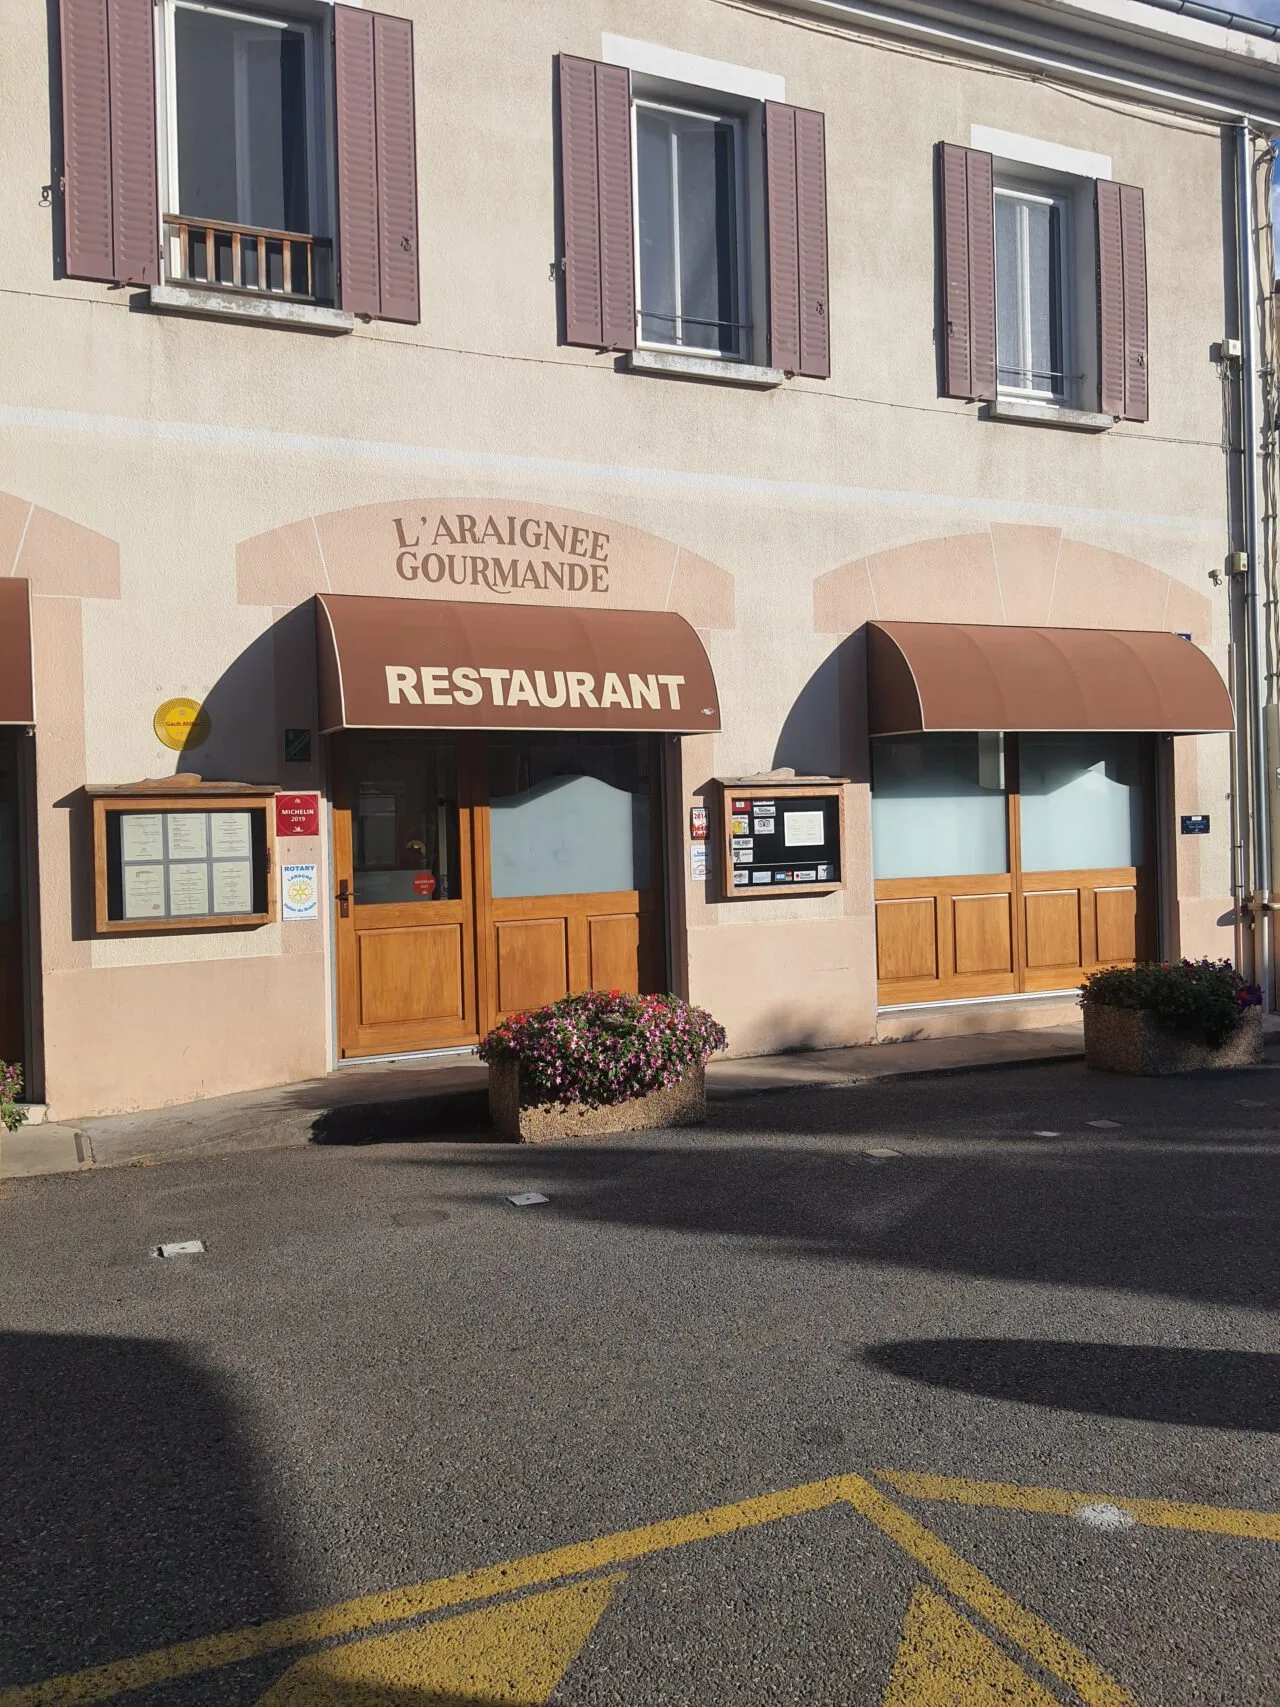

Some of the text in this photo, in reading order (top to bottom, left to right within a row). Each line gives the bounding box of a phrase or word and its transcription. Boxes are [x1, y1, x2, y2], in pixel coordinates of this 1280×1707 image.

[392, 514, 610, 562] L'ARAIGNEE
[396, 551, 610, 594] GOURMANDE
[385, 665, 685, 710] RESTAURANT
